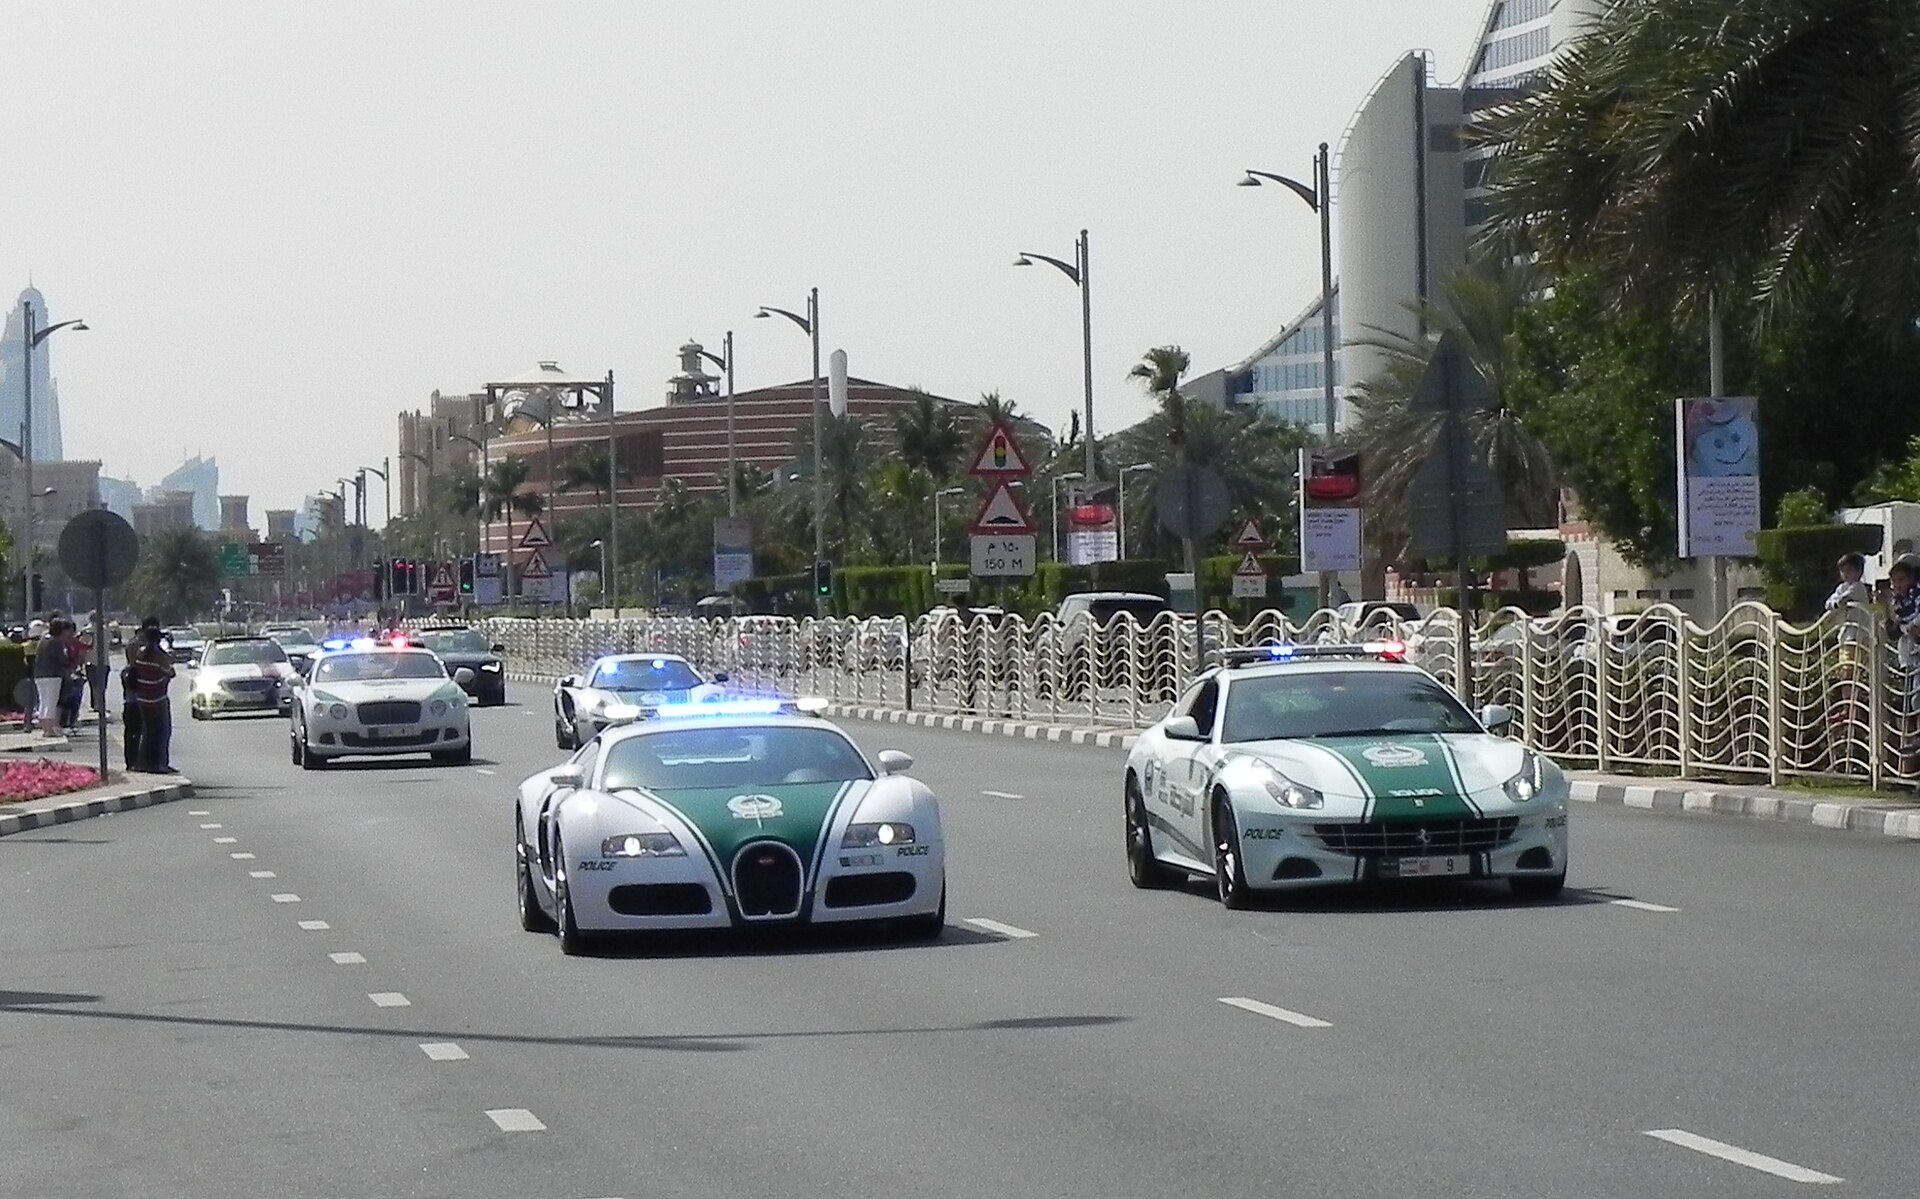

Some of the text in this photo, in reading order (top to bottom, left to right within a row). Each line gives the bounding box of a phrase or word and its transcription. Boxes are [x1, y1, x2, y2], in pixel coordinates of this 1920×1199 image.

[984, 559, 1023, 569] 150 M
[1243, 828, 1285, 840] POLICE
[897, 845, 929, 857] POLICE
[578, 860, 618, 871] POLICE
[1446, 858, 1454, 872] 9
